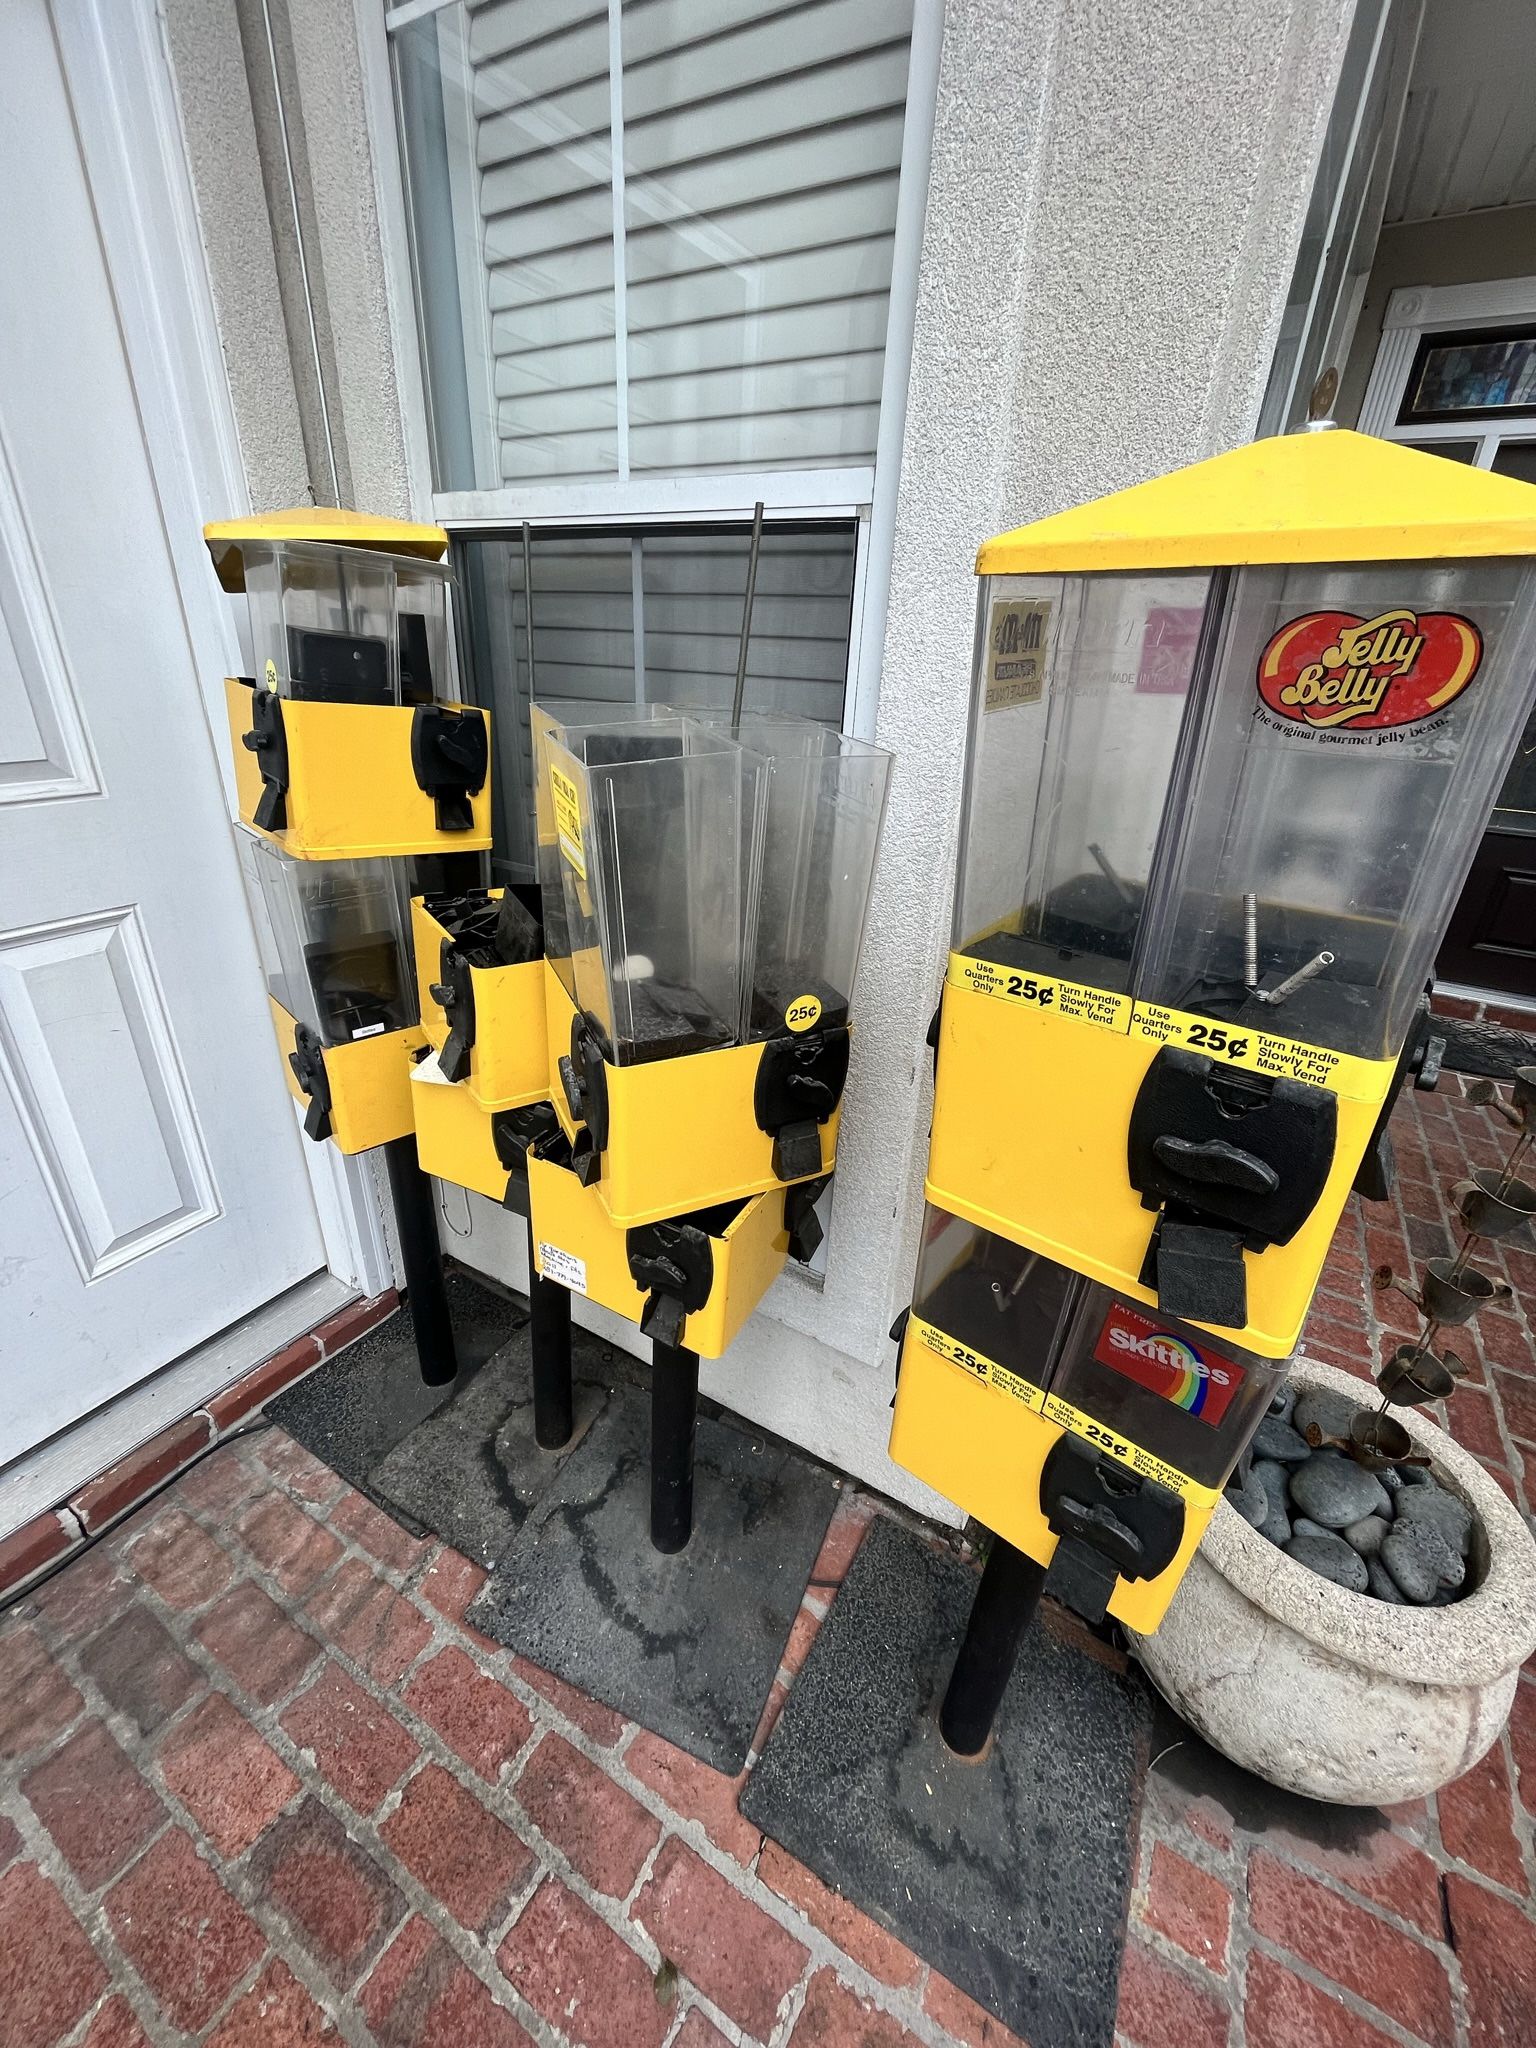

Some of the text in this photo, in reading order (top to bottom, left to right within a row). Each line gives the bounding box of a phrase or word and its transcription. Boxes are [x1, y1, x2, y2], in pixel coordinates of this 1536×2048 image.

[1322, 610, 1424, 676] Jelly
[1280, 663, 1391, 727] Belly
[1251, 704, 1450, 747] The original gourmet jelly bean.
[964, 968, 1004, 986] Quarters
[976, 962, 994, 974] Use
[973, 980, 994, 994] Only
[1007, 976, 1054, 1006] 25¢
[1058, 983, 1121, 1007] Turn Handle
[789, 1005, 817, 1022] 25¢
[1059, 1003, 1114, 1024] Max. Vend
[1060, 994, 1116, 1016] Slowly For
[1148, 1006, 1170, 1020] Use
[1133, 1013, 1182, 1034] Quarters
[1142, 1026, 1169, 1042] Only
[1186, 1024, 1249, 1059] 25¢
[1257, 1035, 1340, 1065] Turn Handle
[1256, 1058, 1327, 1085] Max. Vend
[1258, 1047, 1332, 1075] Slowly For
[1114, 1304, 1131, 1315] FAT
[921, 1329, 951, 1351] Quarters
[927, 1339, 943, 1352] Only
[930, 1328, 944, 1341] Use
[953, 1347, 988, 1375] 25¢
[1109, 1327, 1230, 1386] Skittles
[991, 1364, 1037, 1396] Turn Handle
[992, 1371, 1033, 1399] Slowly For
[1011, 1388, 1030, 1404] Vend
[1047, 1402, 1083, 1427] Quarters
[1053, 1413, 1073, 1428] Only
[1058, 1402, 1075, 1415] Use
[1085, 1425, 1129, 1457] 25¢
[1132, 1461, 1180, 1493] Max. Vend
[1133, 1447, 1189, 1485] Turn Handle
[1134, 1455, 1183, 1488] Slowly For
